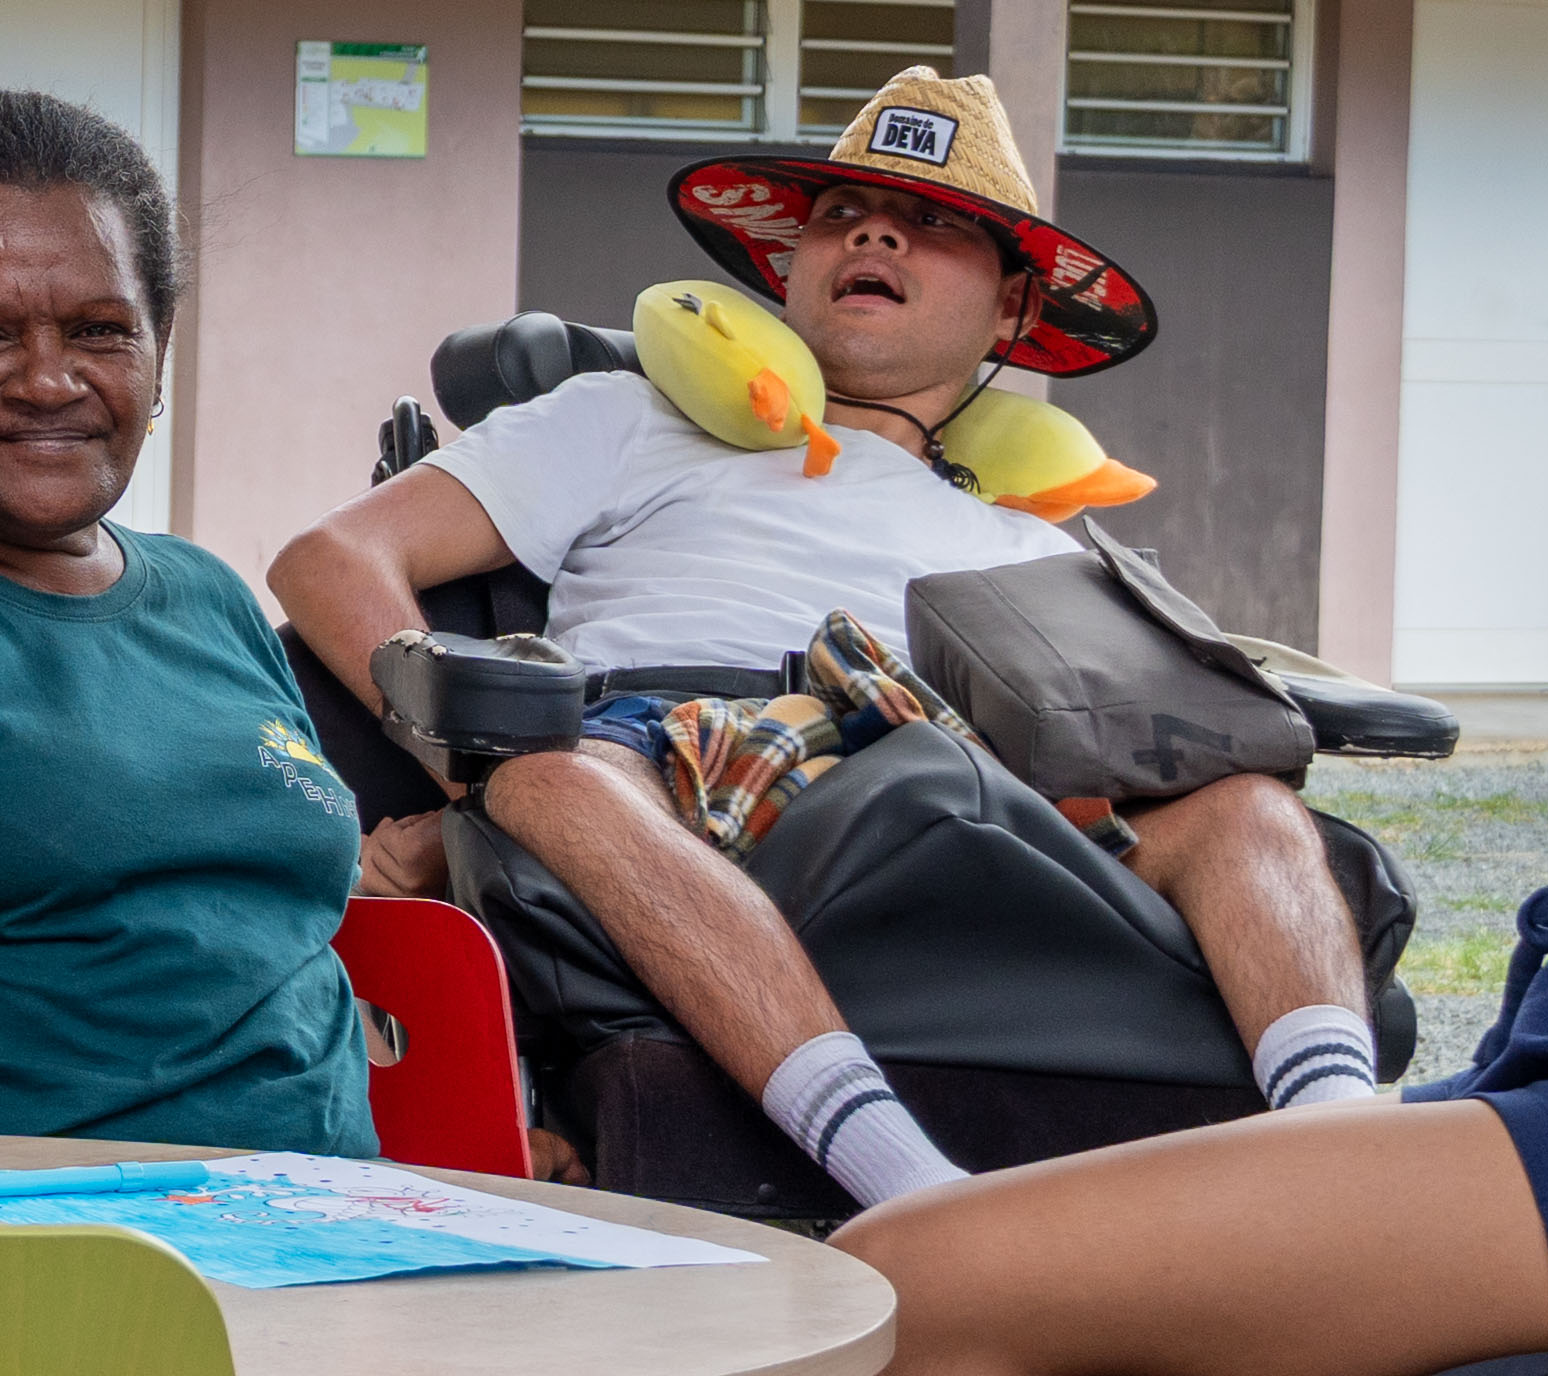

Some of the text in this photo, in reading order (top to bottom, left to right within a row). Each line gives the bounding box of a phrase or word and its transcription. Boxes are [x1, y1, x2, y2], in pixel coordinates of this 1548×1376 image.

[882, 123, 936, 156] DEVA
[923, 119, 934, 129] de
[258, 746, 344, 816] APEH
